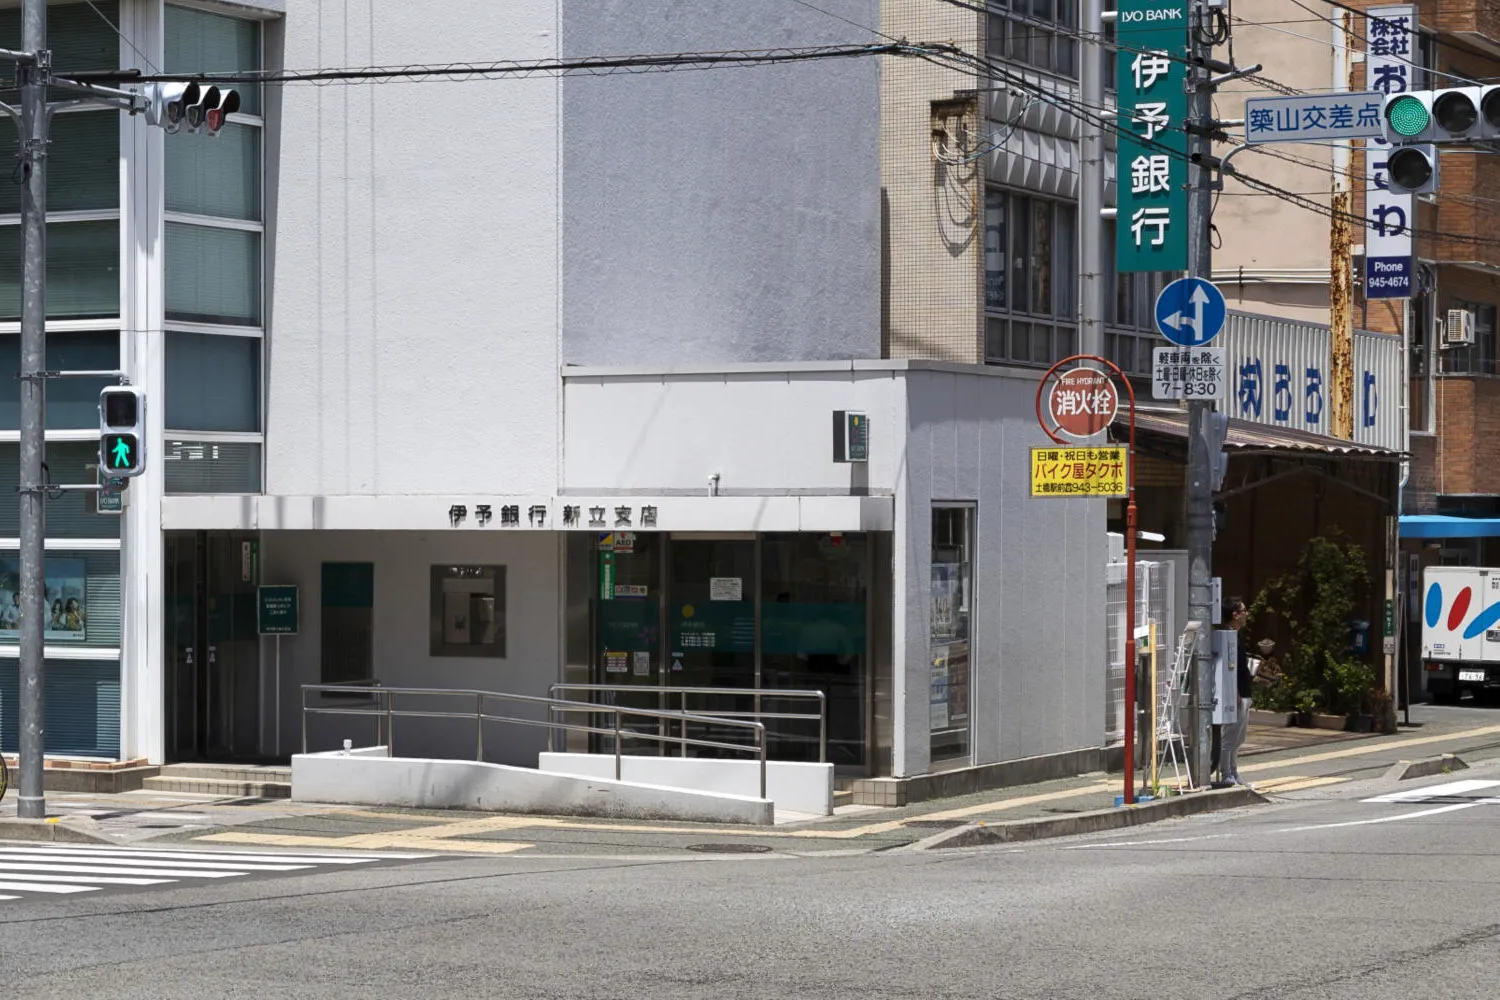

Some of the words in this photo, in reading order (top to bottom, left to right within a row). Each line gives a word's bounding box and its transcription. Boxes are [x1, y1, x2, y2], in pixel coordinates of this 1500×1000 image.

[1122, 10, 1143, 22] IYO
[1146, 8, 1182, 21] BANK
[1370, 16, 1409, 38] 株式
[1370, 36, 1409, 56] 会社
[1250, 102, 1381, 133] 築山交差点
[1131, 49, 1170, 247] 伊予銀行
[1374, 261, 1404, 273] Phone
[1368, 276, 1410, 289] 945-4674
[1159, 351, 1220, 365] 軽車両を除く
[1061, 377, 1076, 386] FIRE
[1077, 377, 1106, 386] HYDRANT
[1056, 389, 1112, 416] 消火栓
[1037, 450, 1121, 461] 日曜・祝日も営業
[1034, 462, 1124, 480] バイク屋タクボ
[448, 504, 547, 527] 伊予銀行
[563, 504, 658, 527] 新立支店
